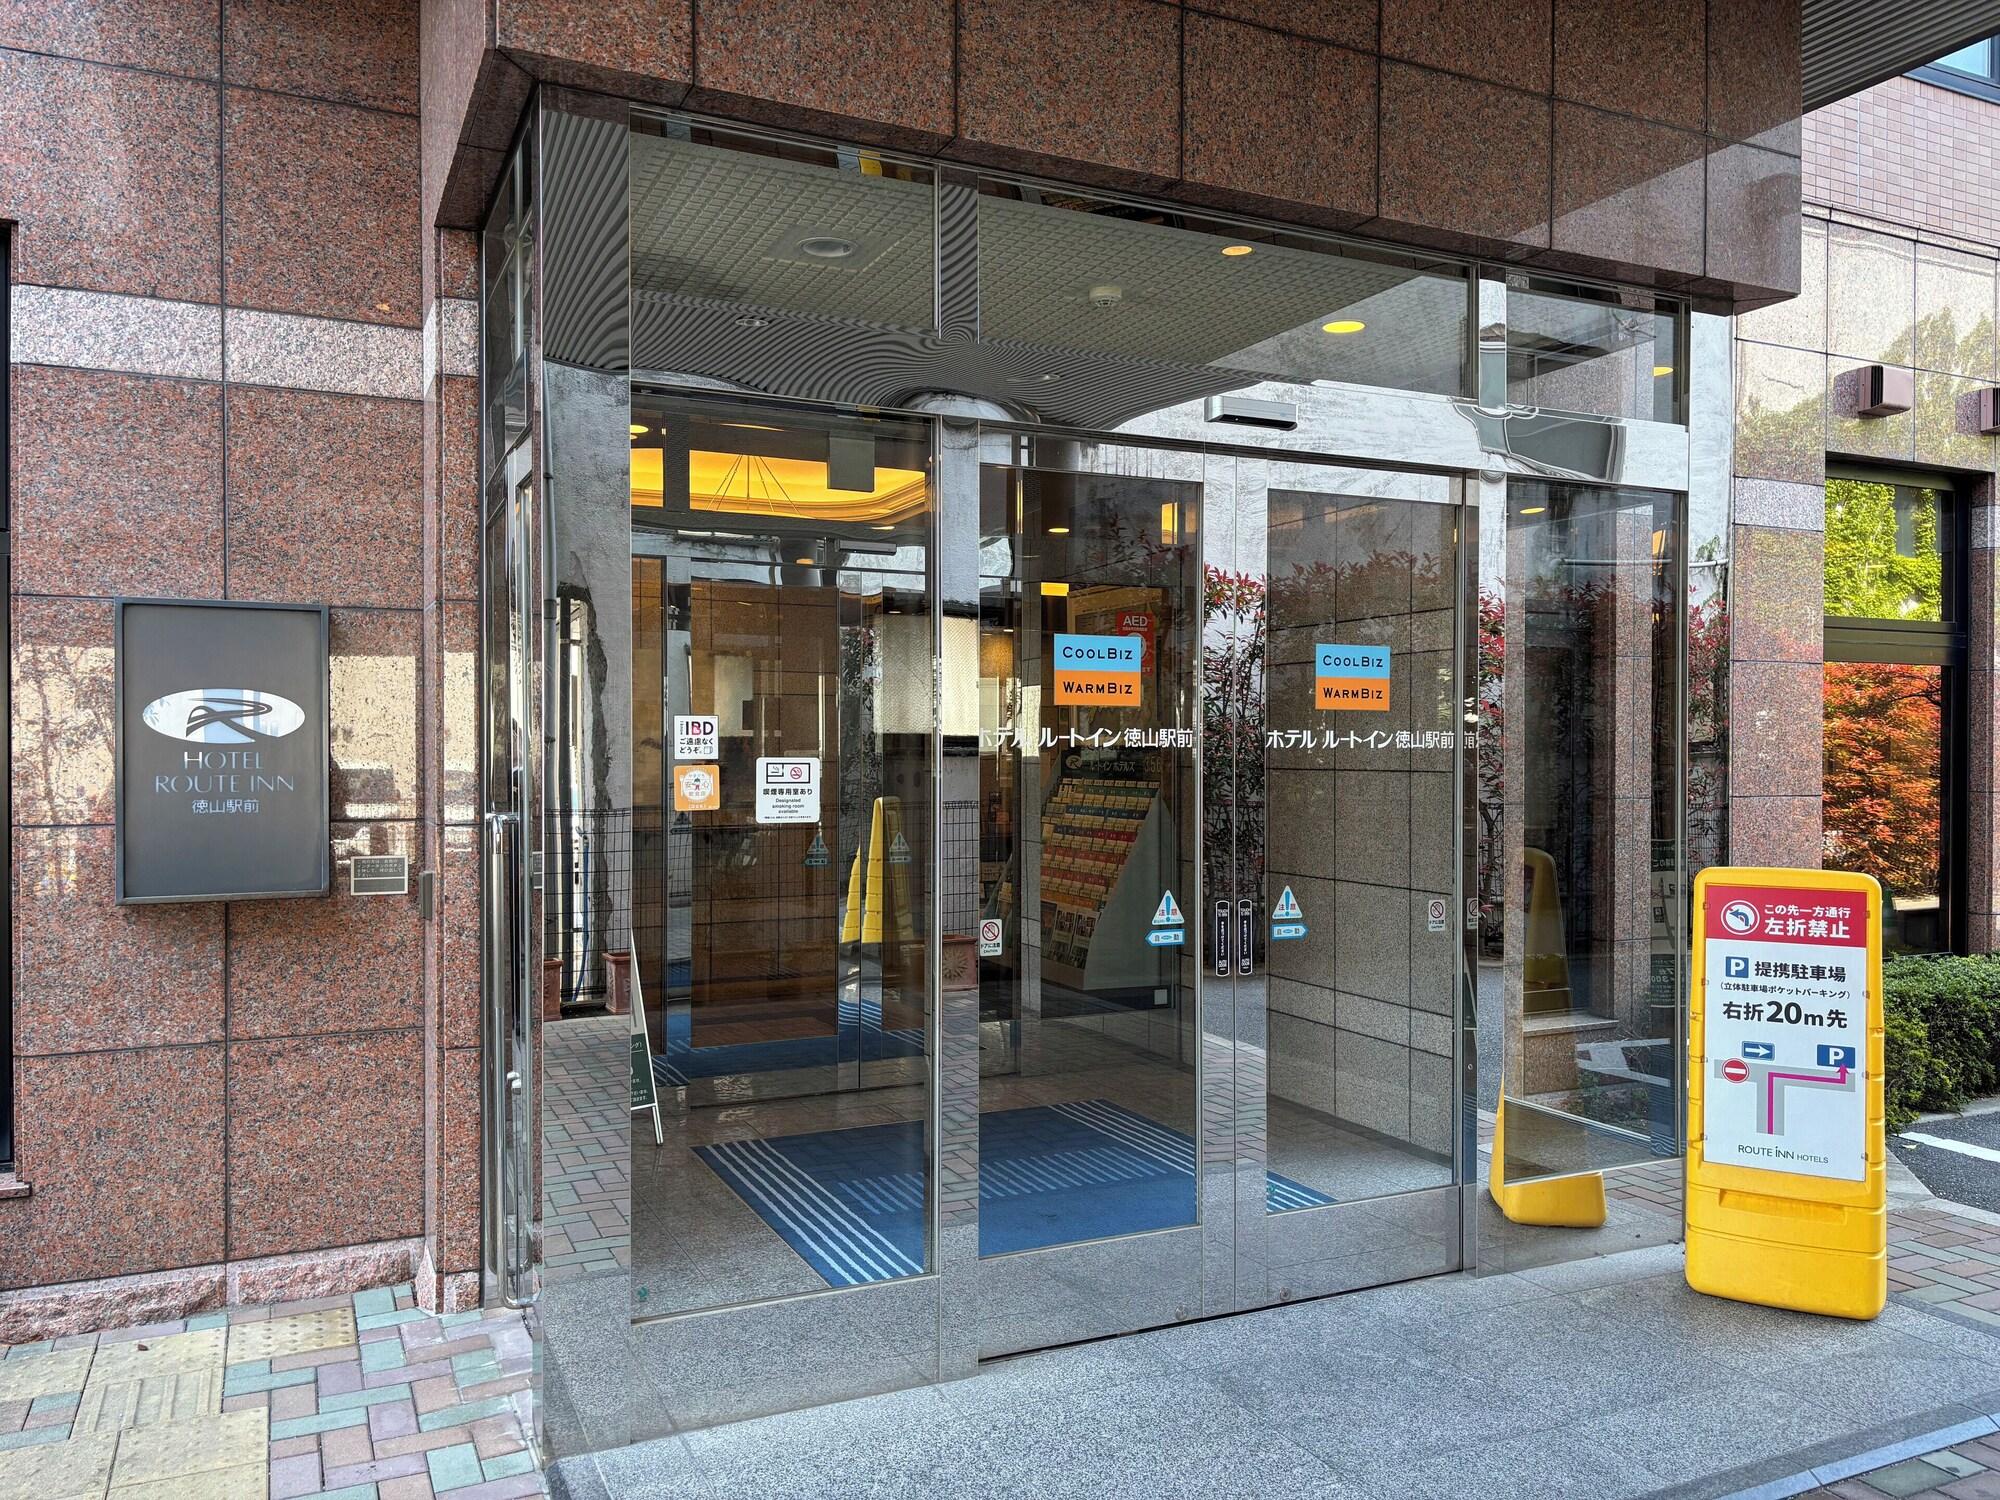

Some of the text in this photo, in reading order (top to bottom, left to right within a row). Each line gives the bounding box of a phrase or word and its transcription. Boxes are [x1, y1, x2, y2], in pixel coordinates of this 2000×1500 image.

[1123, 615, 1148, 627] AED
[685, 721, 714, 736] IBD
[183, 751, 264, 770] HOTEL
[155, 774, 294, 793] ROUTE INN
[191, 799, 259, 814] 徳山駅前
[1764, 904, 1851, 919] この先一方通行
[1764, 917, 1851, 939] 左折禁止
[1754, 961, 1847, 983] 提携駐車場
[1722, 1000, 1848, 1029] 右折20m先
[1738, 1144, 1773, 1157] ROUTE
[1796, 1153, 1829, 1164] HOTELS
